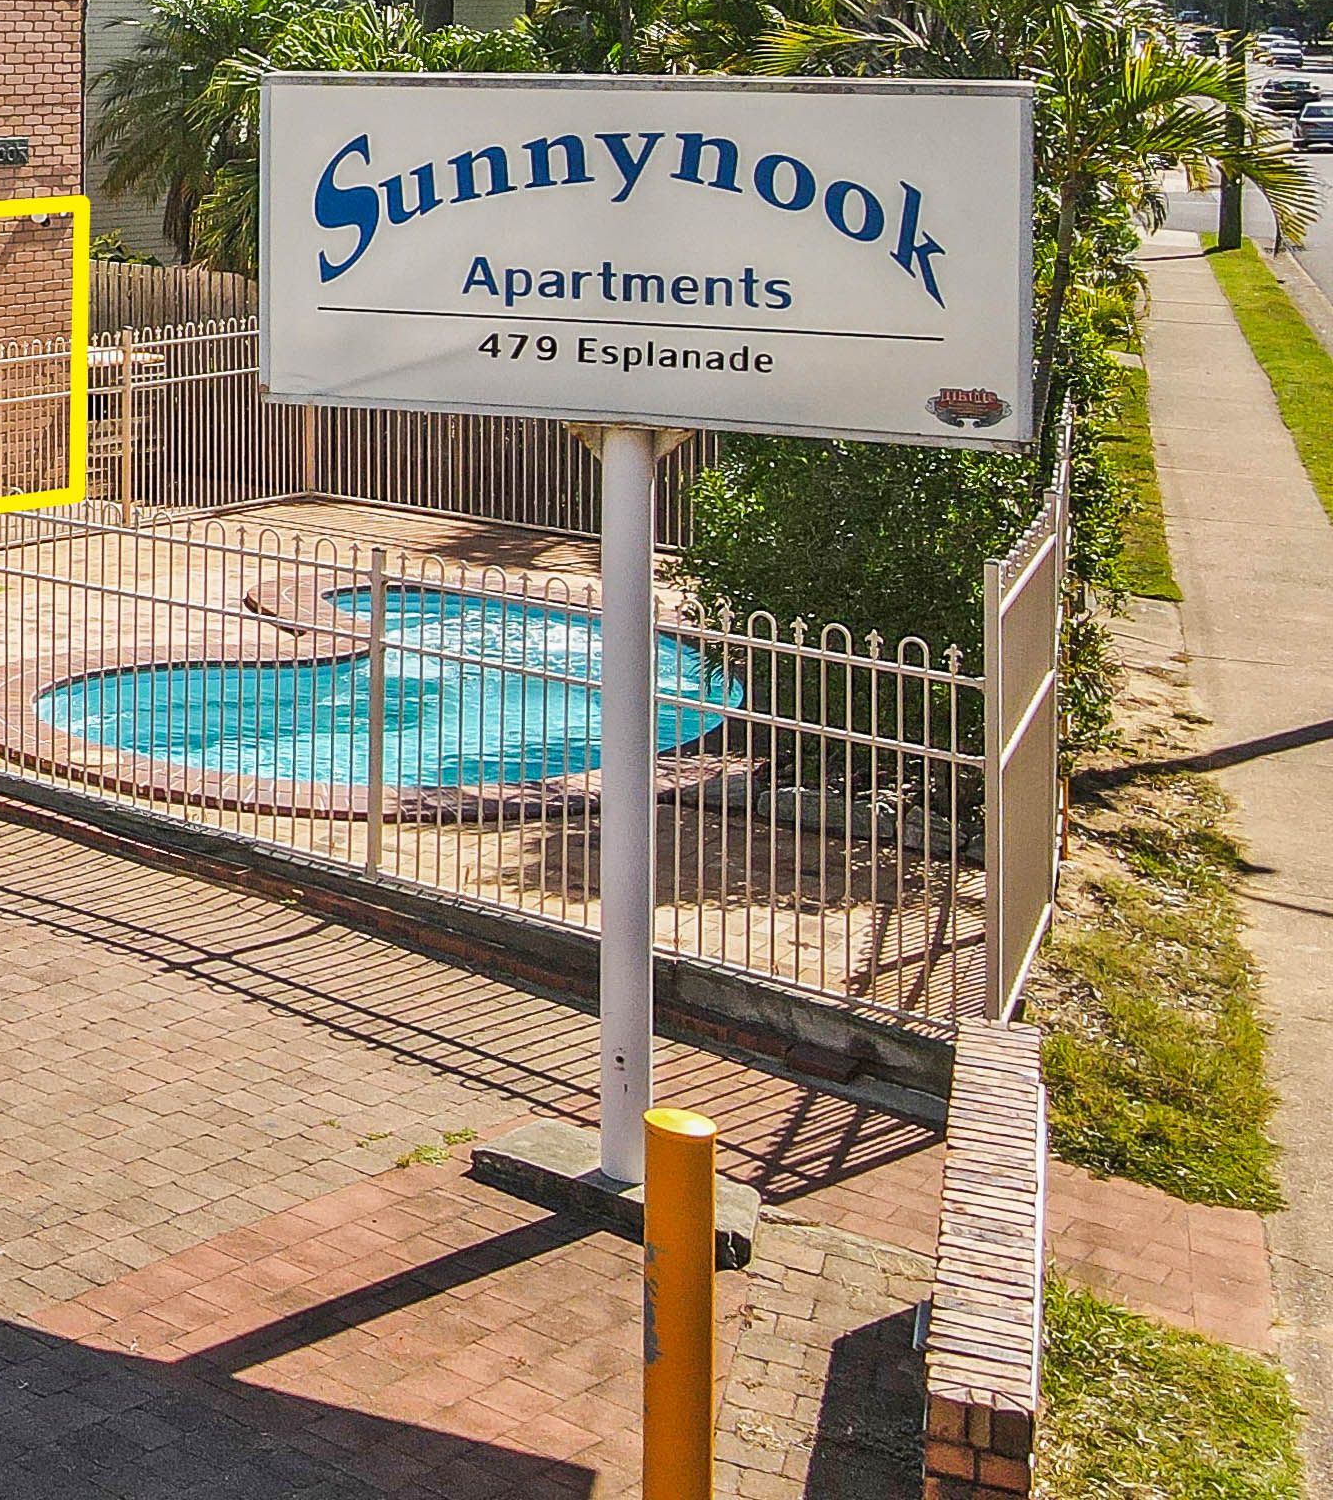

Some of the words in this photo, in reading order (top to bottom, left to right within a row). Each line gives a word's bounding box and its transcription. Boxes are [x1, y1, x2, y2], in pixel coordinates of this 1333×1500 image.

[315, 132, 946, 308] Sunnynook
[462, 255, 793, 310] Apartments
[478, 332, 557, 363] 479
[577, 338, 774, 375] Esplanade
